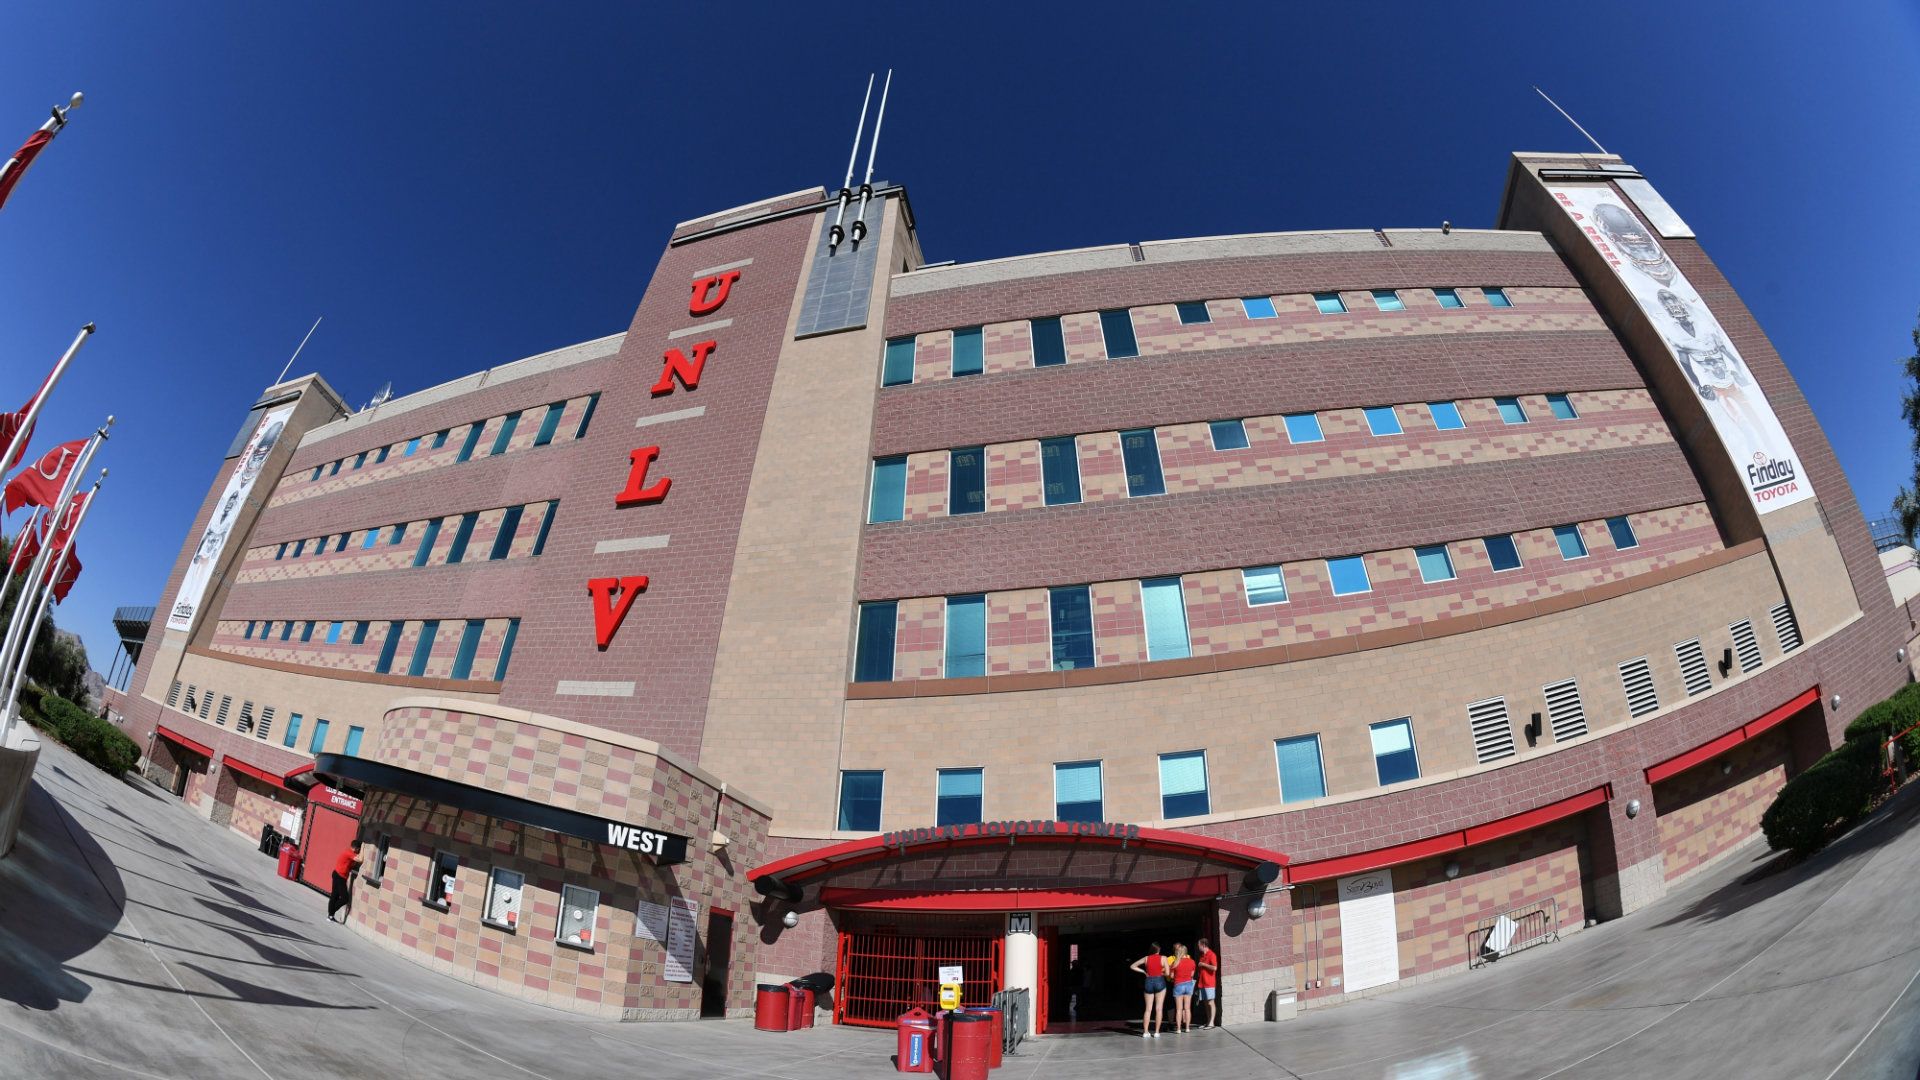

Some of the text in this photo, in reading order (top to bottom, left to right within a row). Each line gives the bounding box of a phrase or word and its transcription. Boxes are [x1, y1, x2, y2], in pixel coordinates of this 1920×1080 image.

[1554, 192, 1622, 273] BE A REBEL.
[586, 270, 741, 648] UNLV
[1747, 458, 1796, 487] Findlay
[1755, 482, 1799, 503] TOYOTA
[331, 795, 357, 809] ENTRANCE
[608, 823, 668, 855] WEST
[883, 819, 1139, 847] FINDLAY TOYOTA TOWER
[1010, 917, 1030, 933] M
